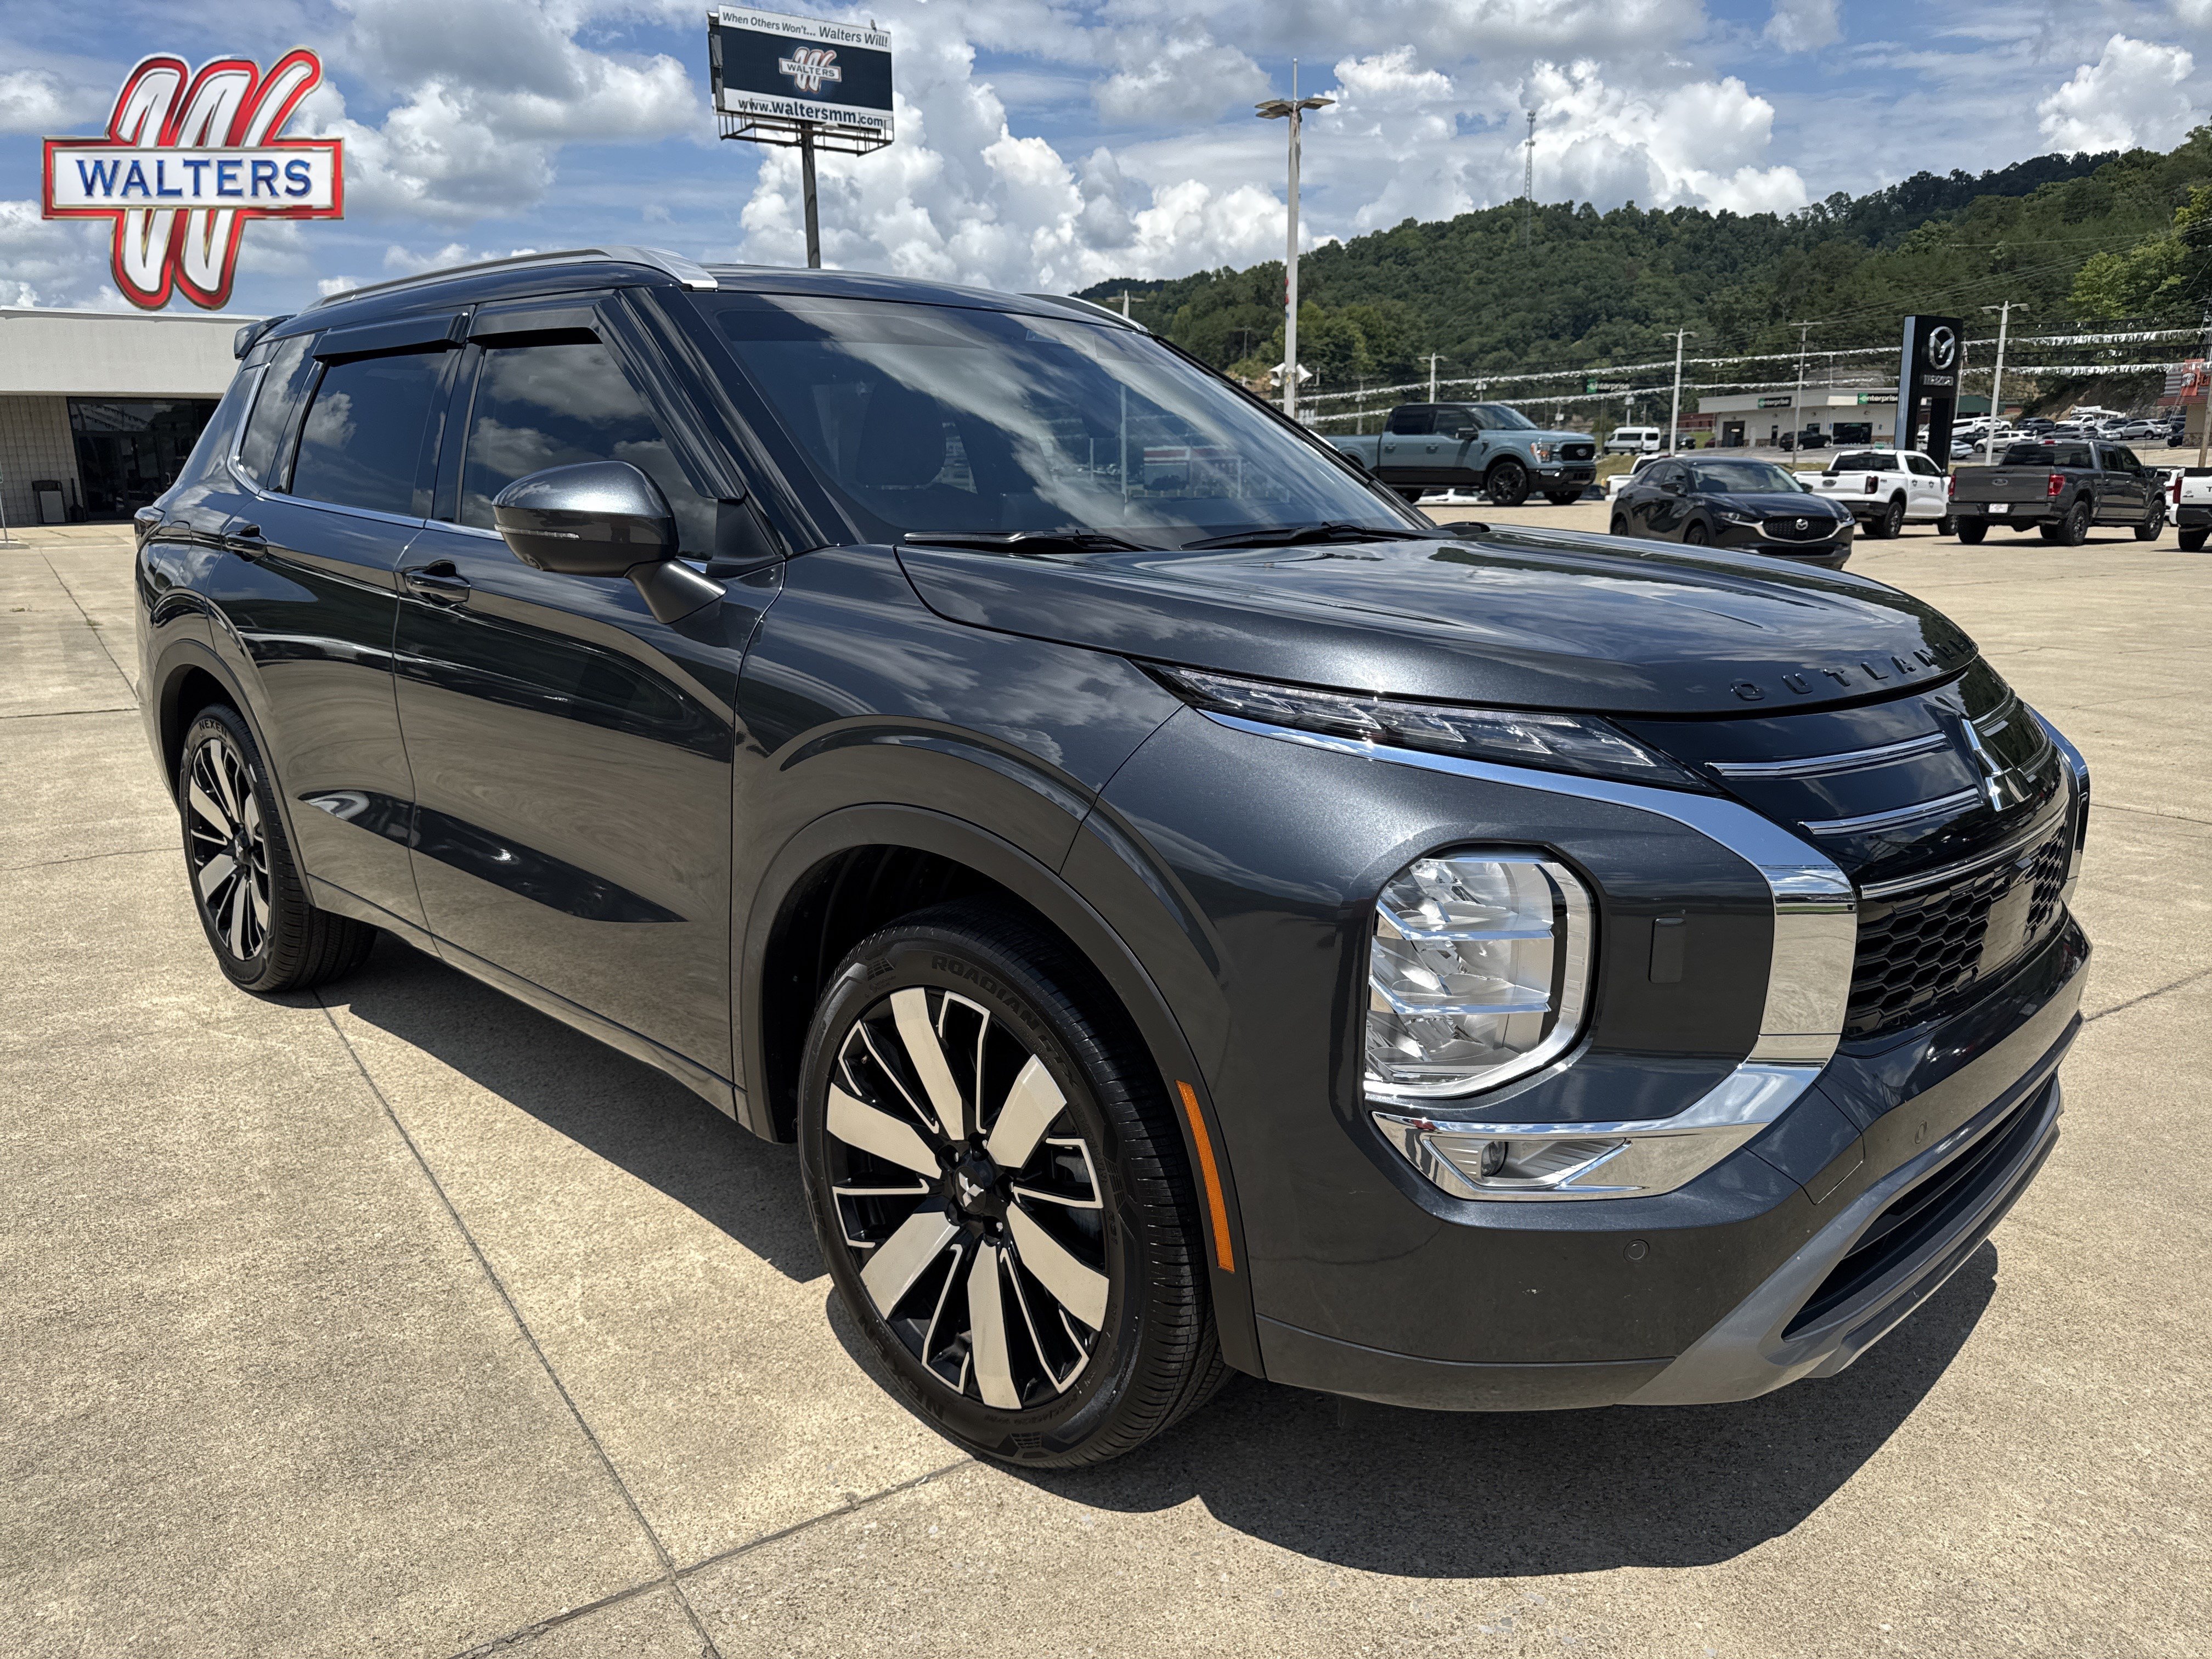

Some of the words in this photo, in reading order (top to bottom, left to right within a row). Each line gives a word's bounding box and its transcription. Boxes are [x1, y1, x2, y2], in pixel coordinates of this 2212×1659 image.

[722, 12, 748, 25] When
[750, 16, 780, 30] Others
[781, 22, 816, 36] Won't...
[819, 26, 862, 43] Walters
[865, 33, 888, 47] Will!
[787, 63, 835, 77] WALTERS
[738, 98, 884, 127] www.Waltersmm.com
[1730, 639, 1970, 702] OUTLANDE
[199, 719, 228, 739] NEXEN
[932, 955, 1040, 1031] ROADIAN
[1037, 1035, 1079, 1087] GTX
